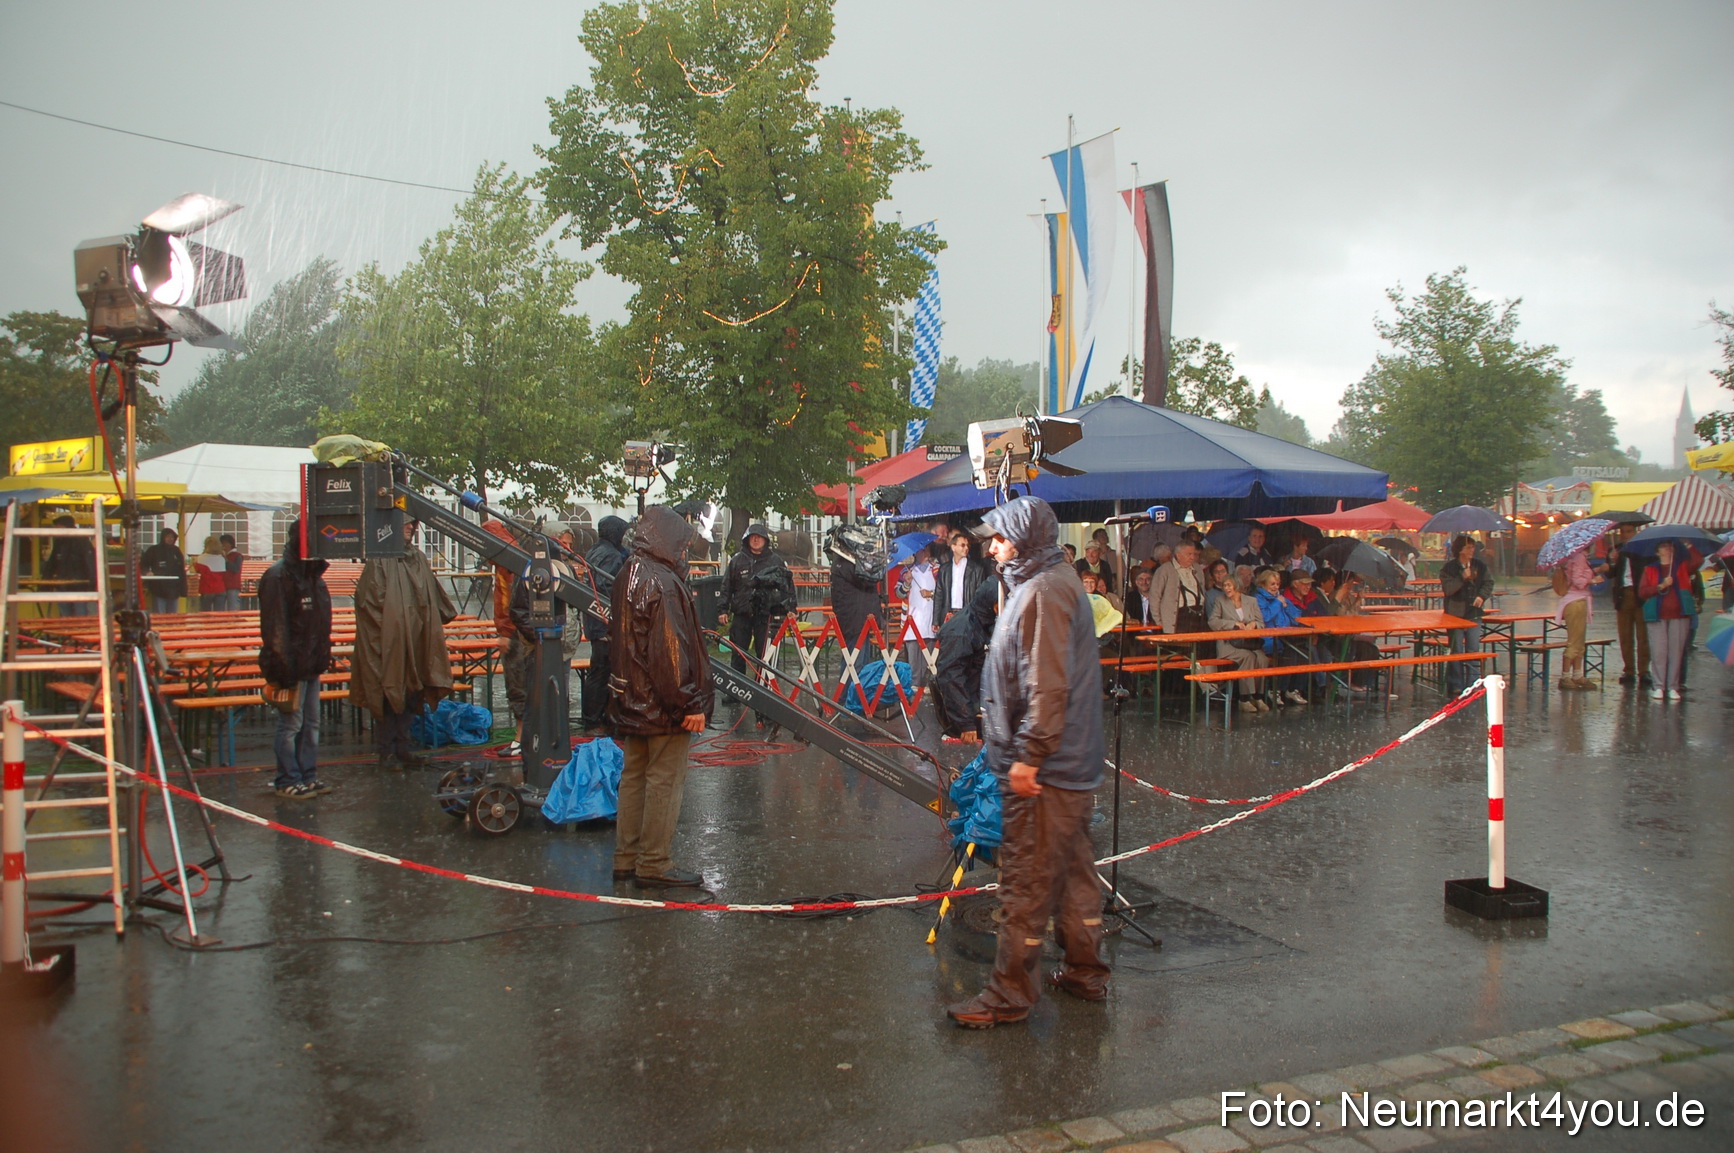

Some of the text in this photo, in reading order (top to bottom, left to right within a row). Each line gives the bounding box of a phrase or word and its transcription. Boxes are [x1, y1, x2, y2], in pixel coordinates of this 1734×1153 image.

[934, 445, 961, 453] COCKTAIL
[1573, 466, 1630, 478] REITSALON
[327, 479, 352, 492] Felix
[377, 524, 393, 541] Felix
[726, 679, 752, 701] Tech
